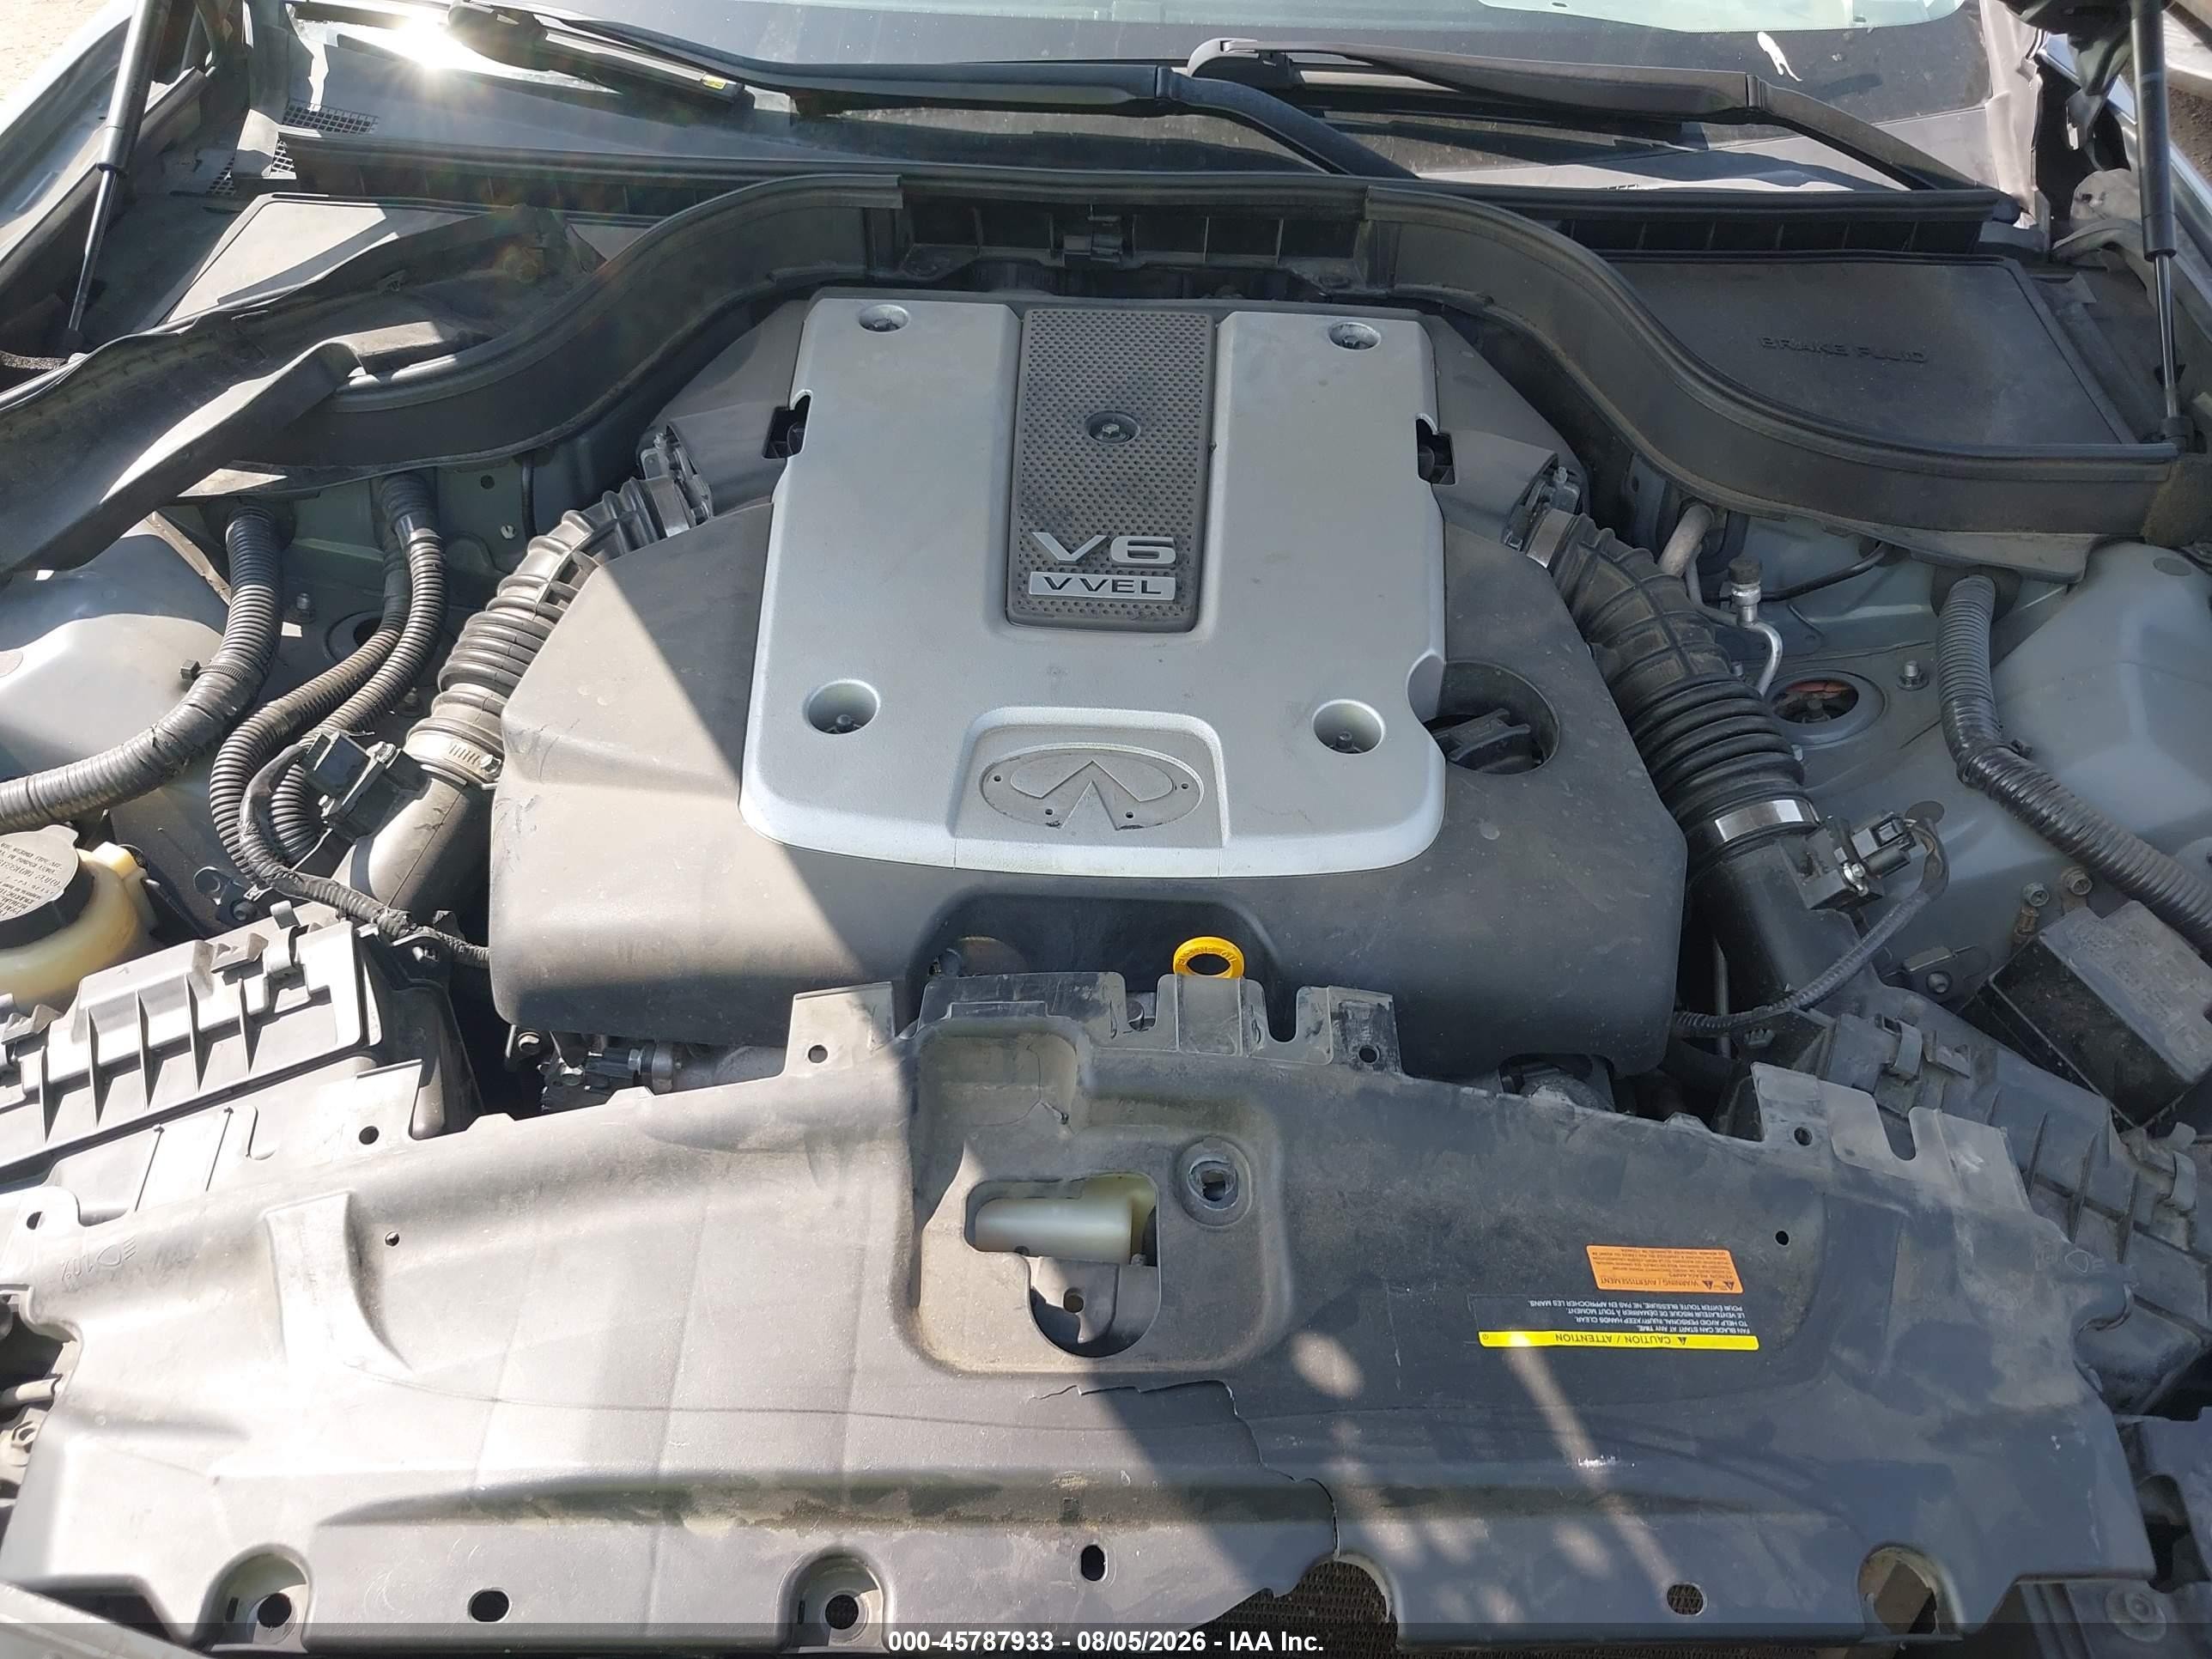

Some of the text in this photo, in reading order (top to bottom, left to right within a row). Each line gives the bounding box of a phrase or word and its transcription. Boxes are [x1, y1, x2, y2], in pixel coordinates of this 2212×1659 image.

[1761, 337, 1925, 364] BRAKE FLUID
[1031, 532, 1176, 566] V6
[1042, 575, 1162, 595] VVEL
[1600, 1277, 1656, 1286] AVERTISSEMENT
[1555, 1334, 1613, 1343] ATTENTION
[1624, 1335, 1671, 1345] CAUTION
